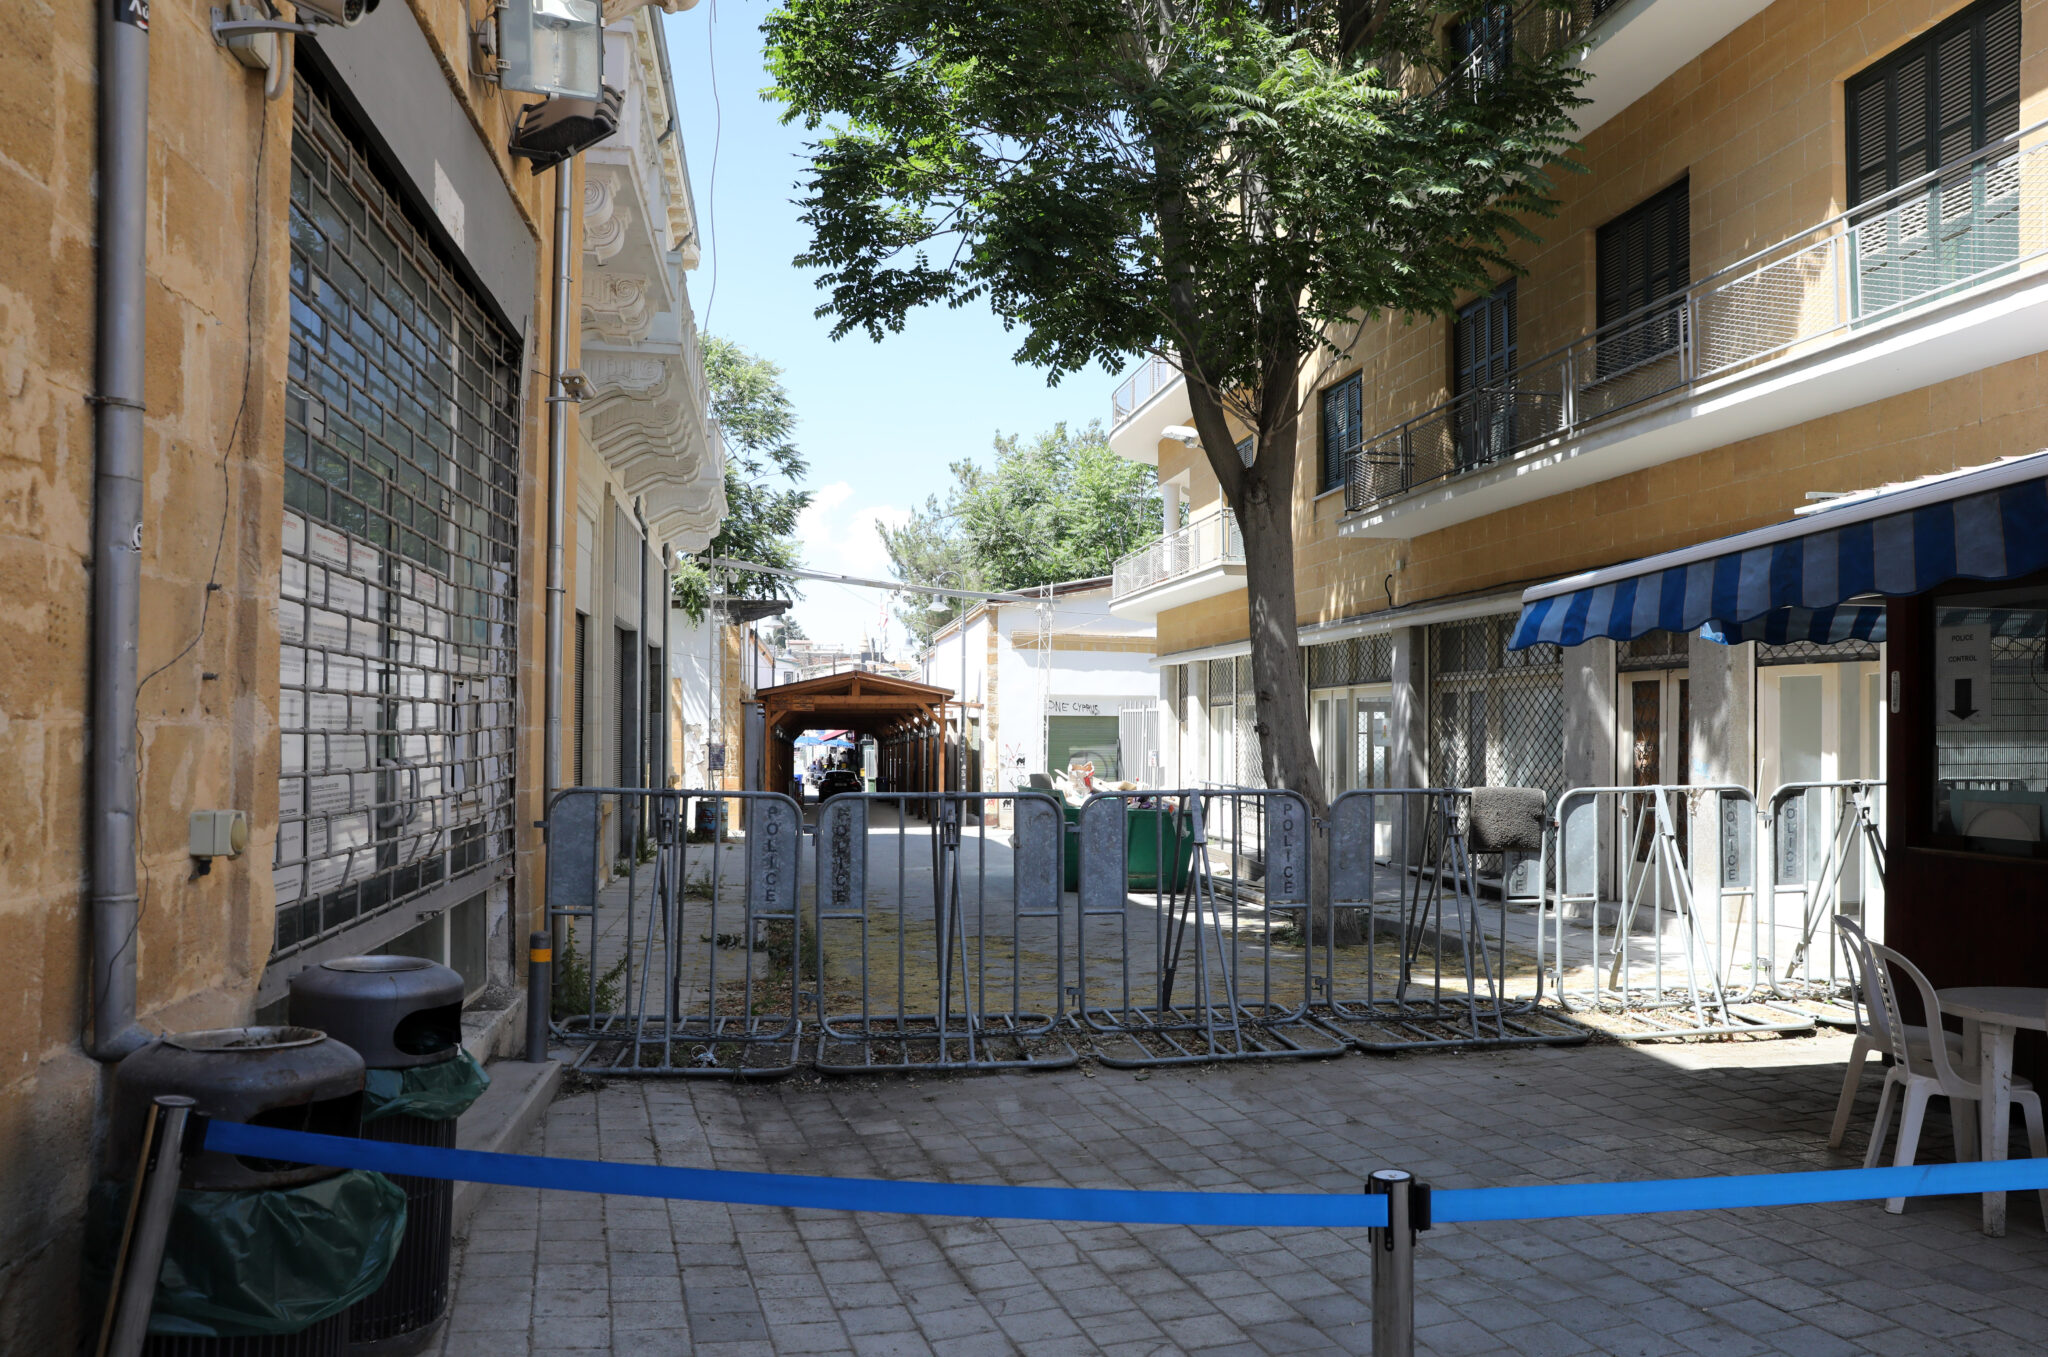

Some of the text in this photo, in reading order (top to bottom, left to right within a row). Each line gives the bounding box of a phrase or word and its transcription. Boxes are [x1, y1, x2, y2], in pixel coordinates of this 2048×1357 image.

[1948, 655, 1977, 663] CONTROL
[1951, 634, 1975, 642] POLICE
[765, 806, 779, 902] POLICE
[1282, 803, 1294, 894] POLICE
